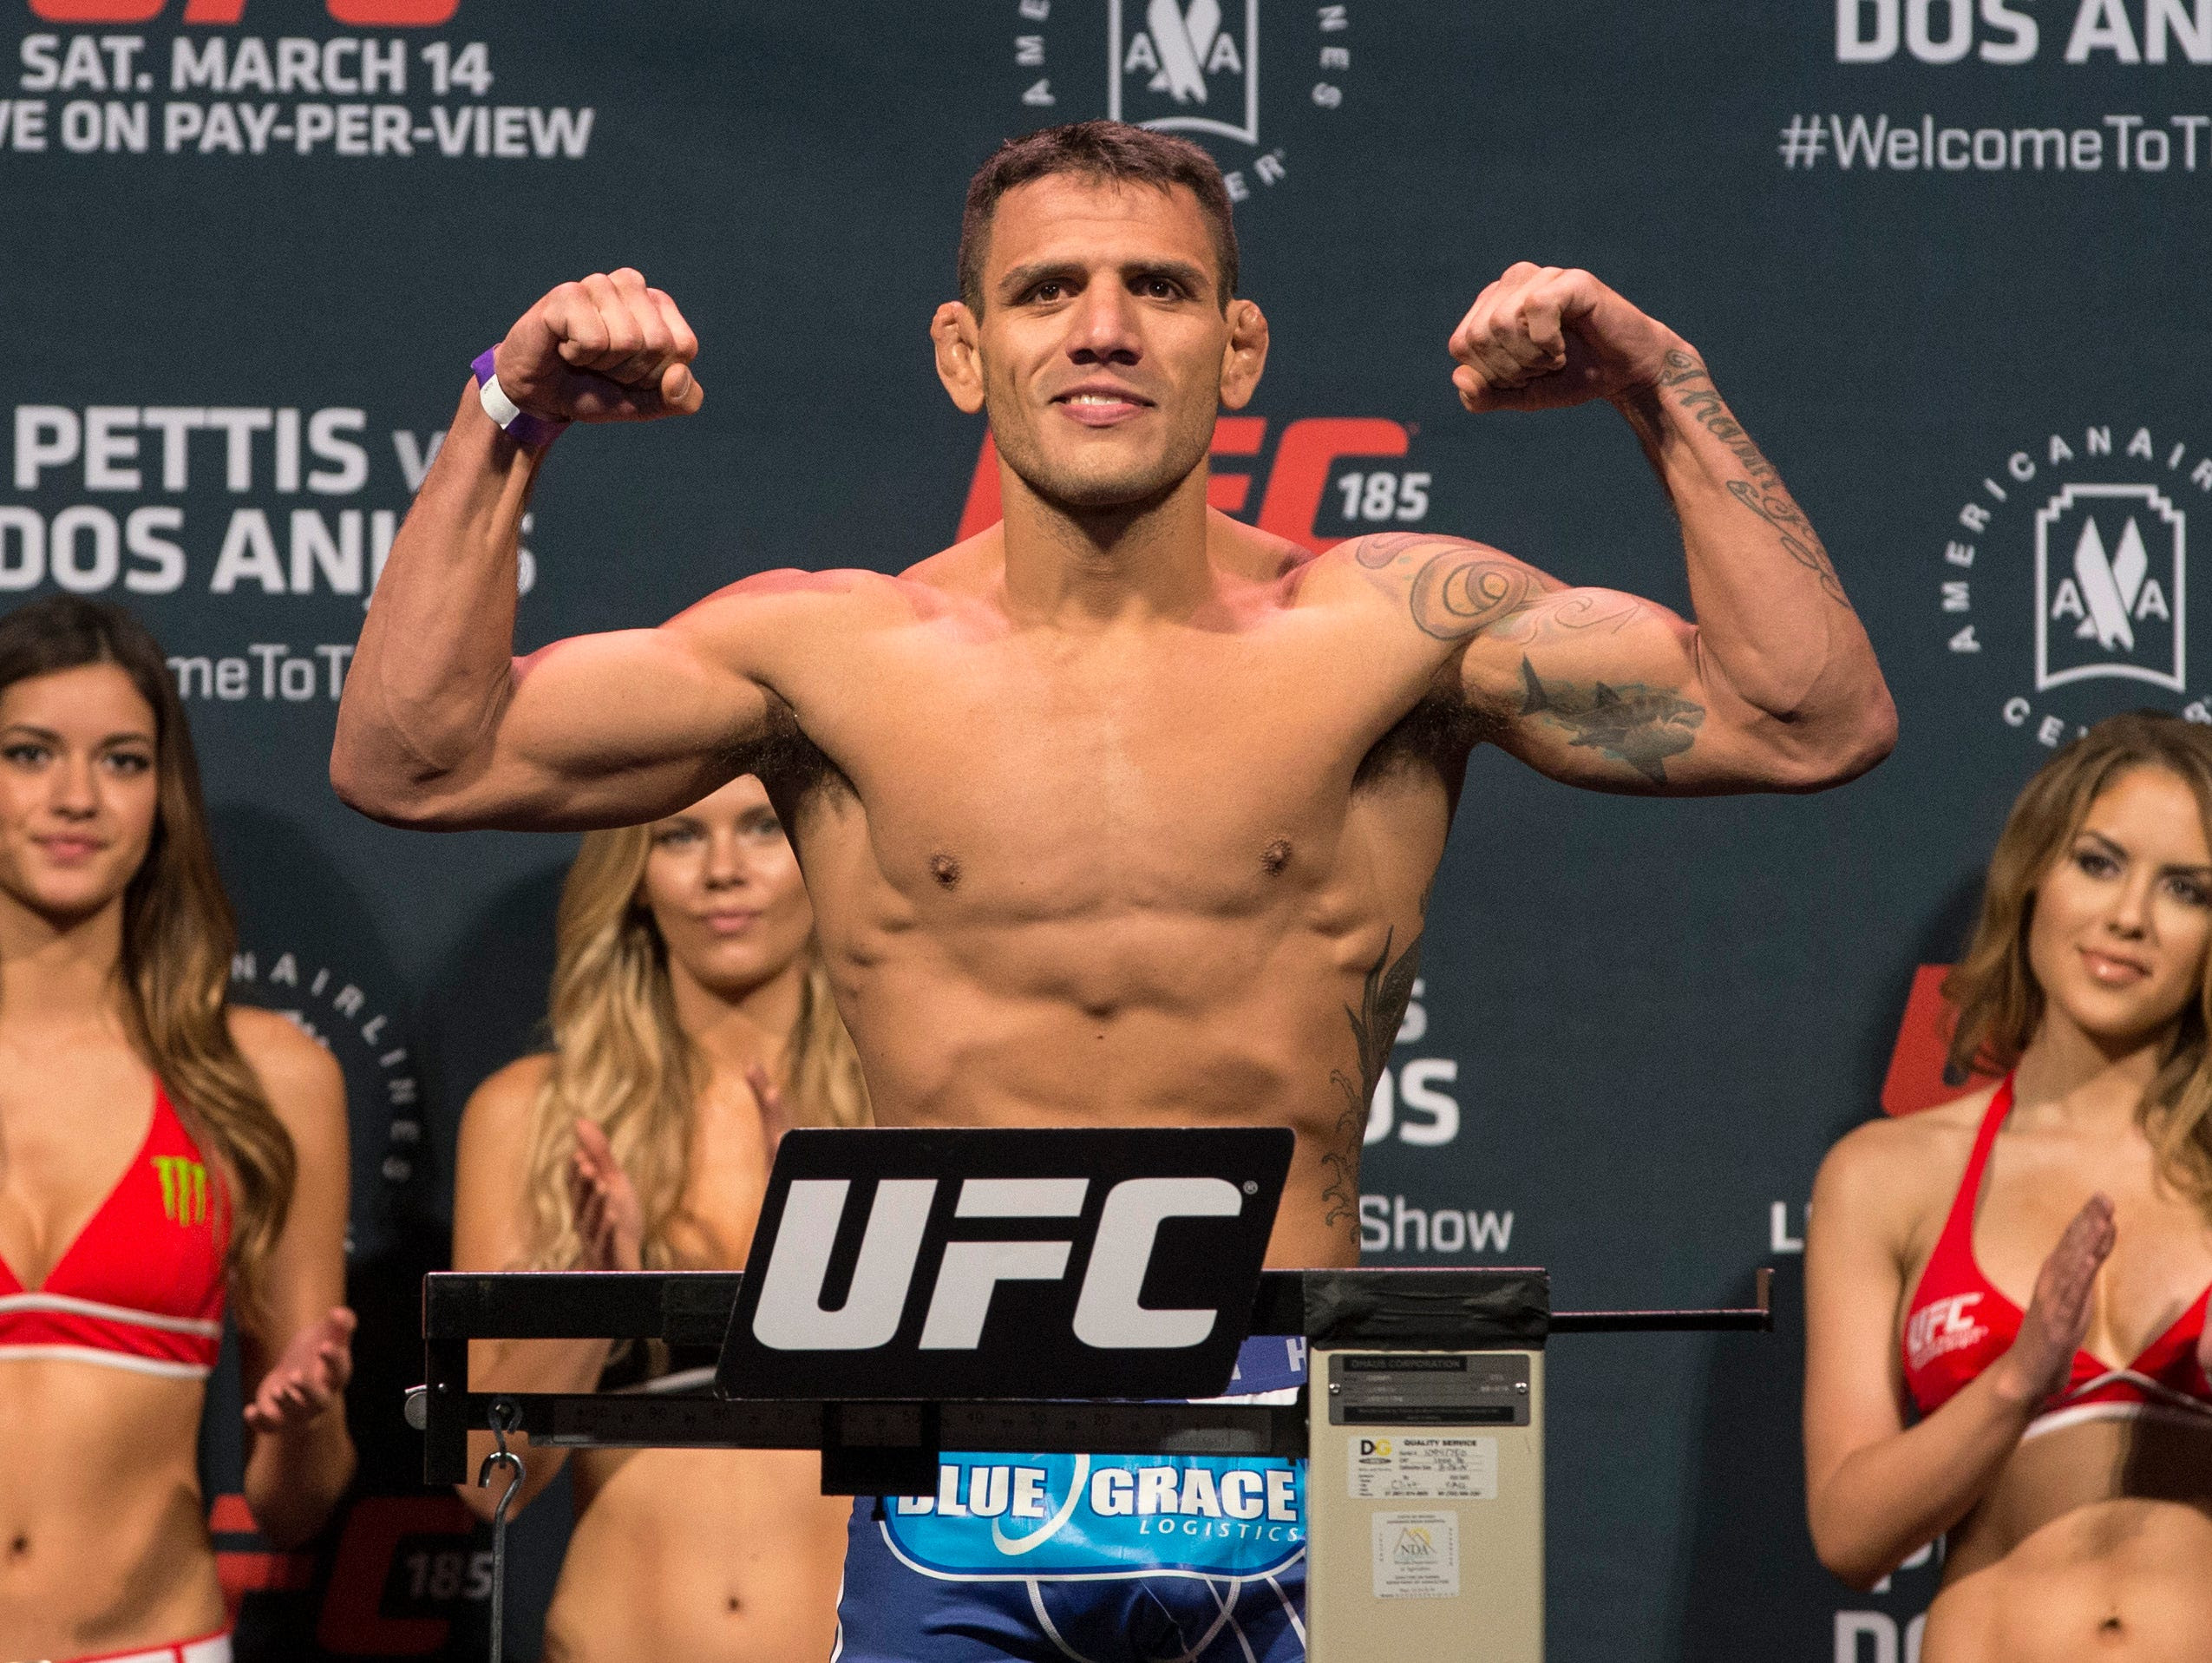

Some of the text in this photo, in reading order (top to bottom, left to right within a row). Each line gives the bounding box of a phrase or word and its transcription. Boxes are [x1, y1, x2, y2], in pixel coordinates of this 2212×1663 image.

[1835, 0, 2039, 63] DOS
[19, 34, 494, 97] SAT. MARCH 14
[61, 101, 149, 153] ON
[163, 102, 596, 159] PAY-PER-VIEW
[1777, 114, 2211, 171] #WelcomeToT
[14, 403, 370, 494] PETTIS
[1337, 472, 1432, 522] 185
[0, 505, 187, 593] DOS
[1358, 1194, 1515, 1253] Show
[751, 1177, 1244, 1351] UFC
[1090, 1466, 1298, 1522] GRACE
[1139, 1519, 1299, 1542] LOGISTICS
